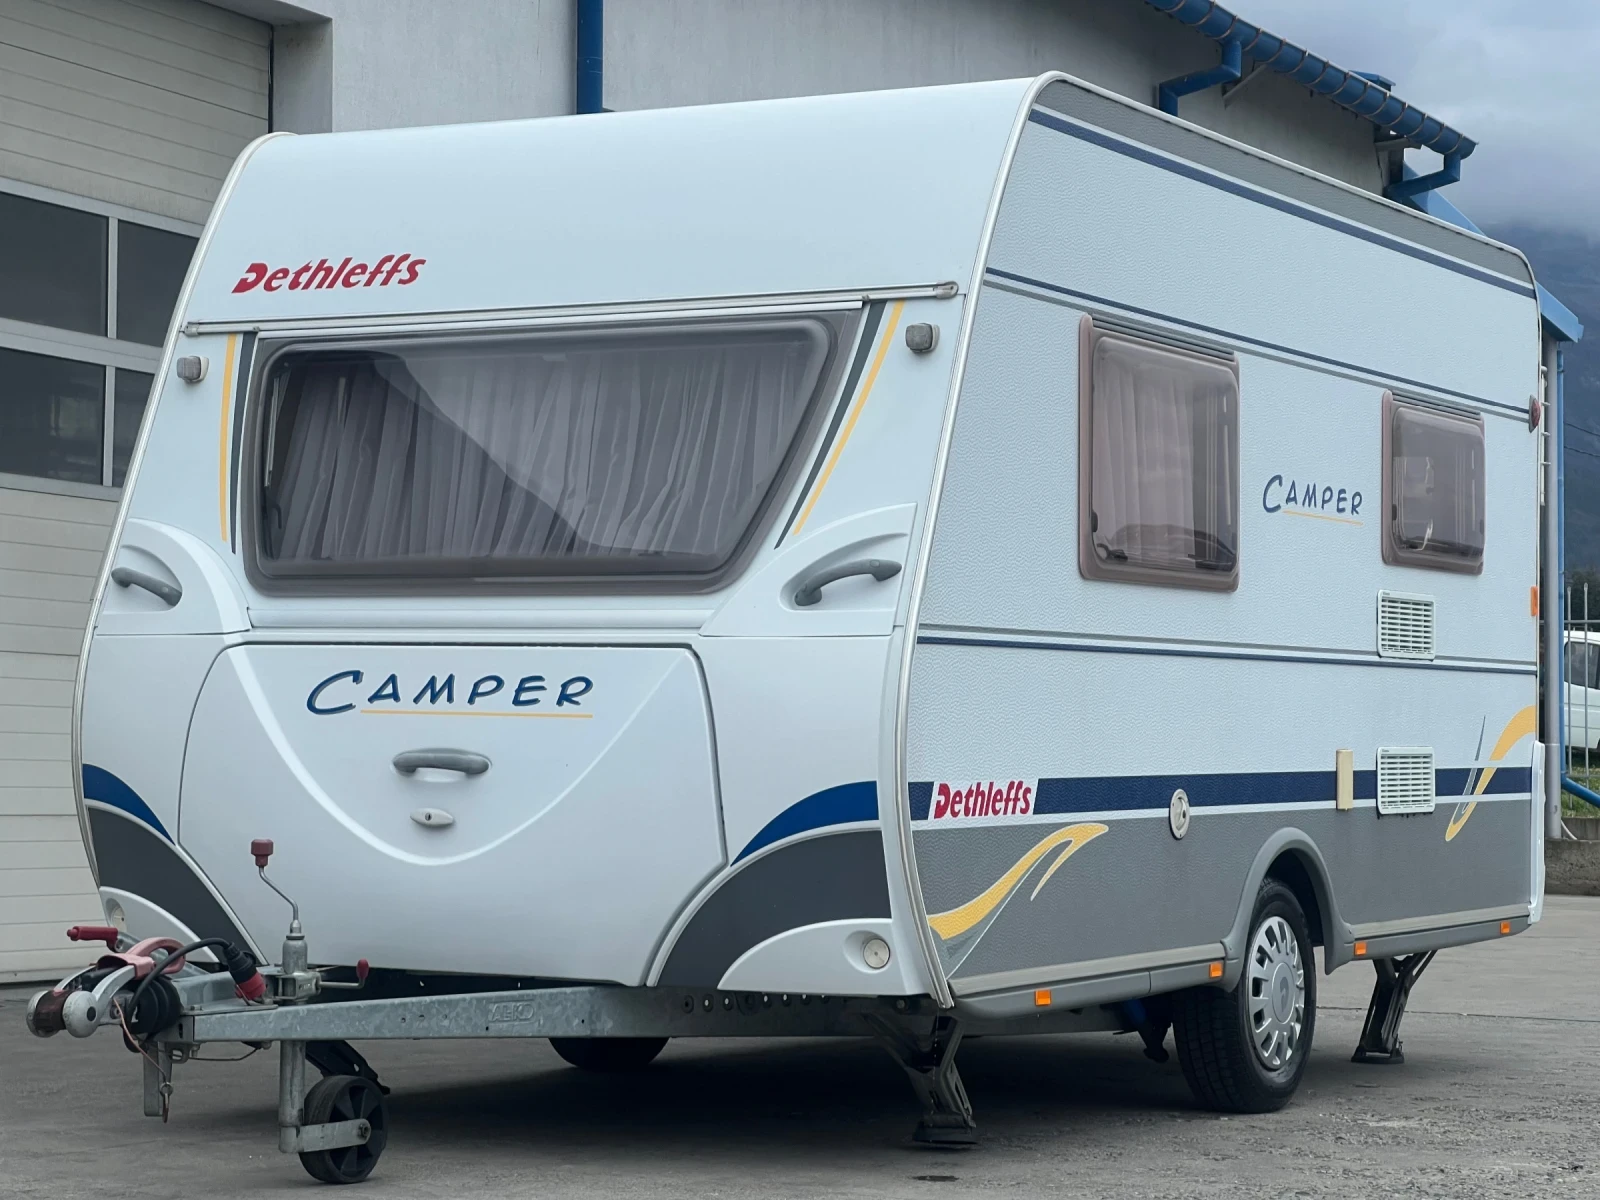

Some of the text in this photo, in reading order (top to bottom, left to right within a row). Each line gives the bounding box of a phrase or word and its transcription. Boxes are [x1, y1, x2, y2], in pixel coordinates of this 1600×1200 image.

[231, 253, 427, 294] Dethleffs
[1262, 474, 1363, 516] CAMPER
[306, 669, 594, 715] CAMPER
[933, 780, 1032, 819] Dethleffs
